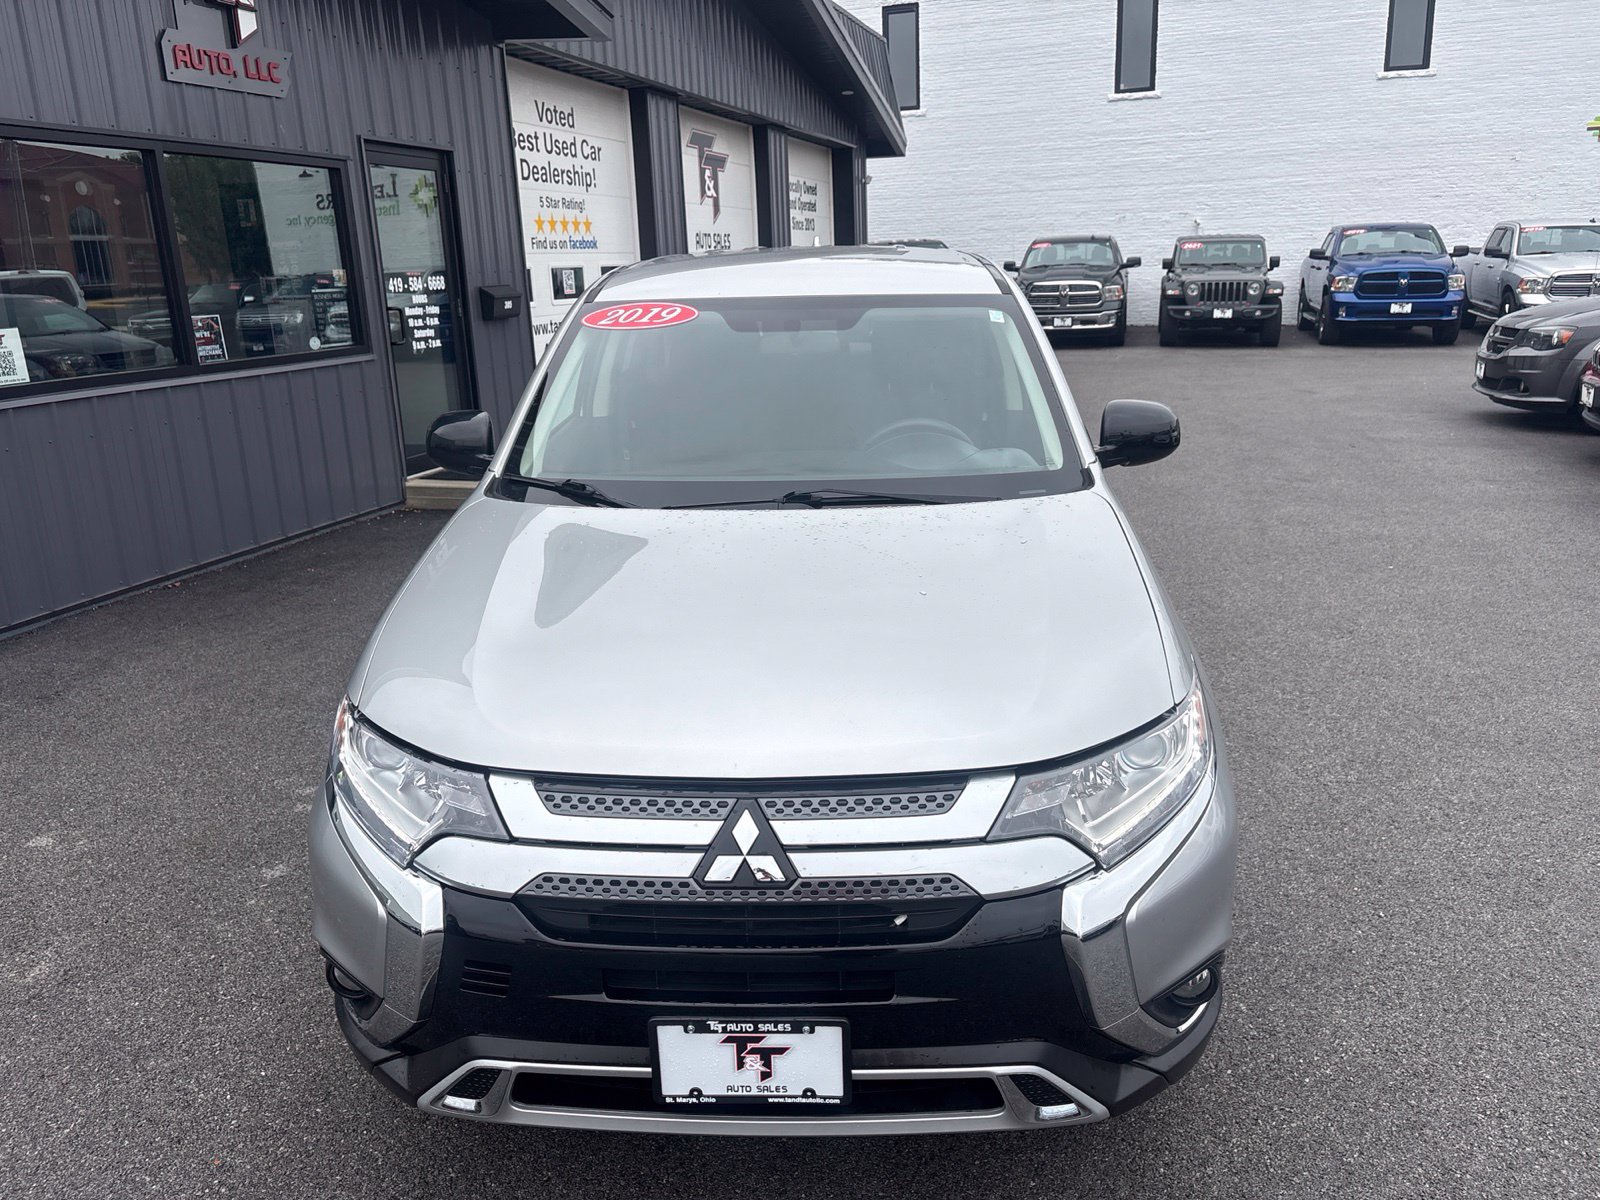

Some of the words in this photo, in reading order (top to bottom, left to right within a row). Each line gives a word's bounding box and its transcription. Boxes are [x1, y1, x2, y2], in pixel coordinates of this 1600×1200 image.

[242, 54, 281, 84] LLC
[534, 99, 575, 129] Voted
[543, 131, 577, 159] Used
[580, 138, 602, 162] Car
[519, 158, 597, 193] Dealership!
[789, 179, 803, 197] ocally
[803, 180, 817, 196] Owned
[539, 196, 545, 209] 5
[545, 197, 560, 210] Star
[561, 197, 586, 214] Rating!
[798, 197, 817, 213] Operated
[791, 216, 804, 231] Since
[531, 237, 548, 250] Find
[549, 239, 557, 250] us
[558, 239, 568, 250] on
[568, 236, 598, 250] facebook
[695, 233, 712, 250] AUTO
[713, 233, 731, 250] SALES
[412, 294, 428, 304] HOURS
[404, 306, 423, 316] Monday
[425, 305, 440, 315] Friday
[597, 306, 682, 326] 2019
[413, 328, 435, 338] Saturday
[532, 319, 562, 336] ww.ta
[727, 1022, 754, 1032] AUTO
[758, 1022, 792, 1032] SALES
[726, 1085, 752, 1093] AUTO
[756, 1085, 788, 1093] SALES
